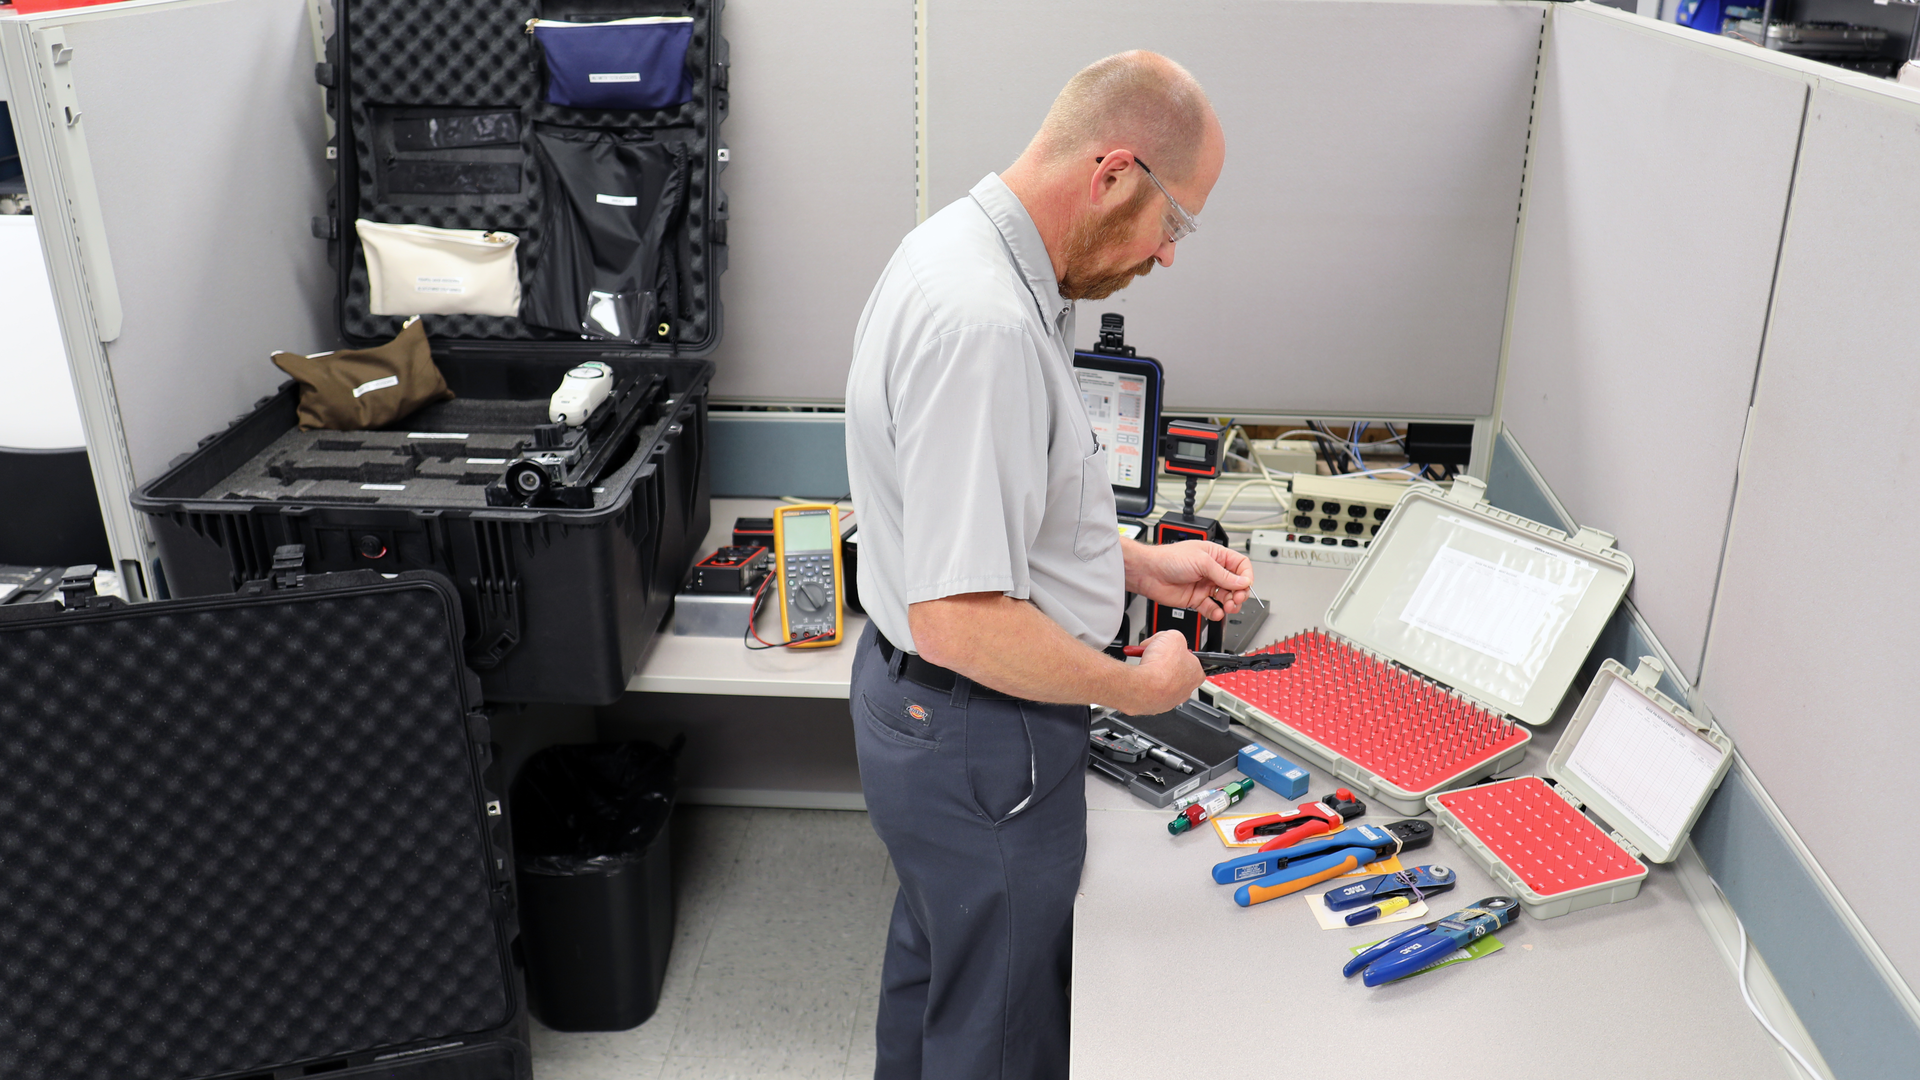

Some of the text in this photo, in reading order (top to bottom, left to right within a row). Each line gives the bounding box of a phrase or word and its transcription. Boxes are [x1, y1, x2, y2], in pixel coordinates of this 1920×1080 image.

[1281, 548, 1308, 560] LEAD
[1311, 550, 1340, 565] ACID
[1343, 884, 1366, 896] DMC
